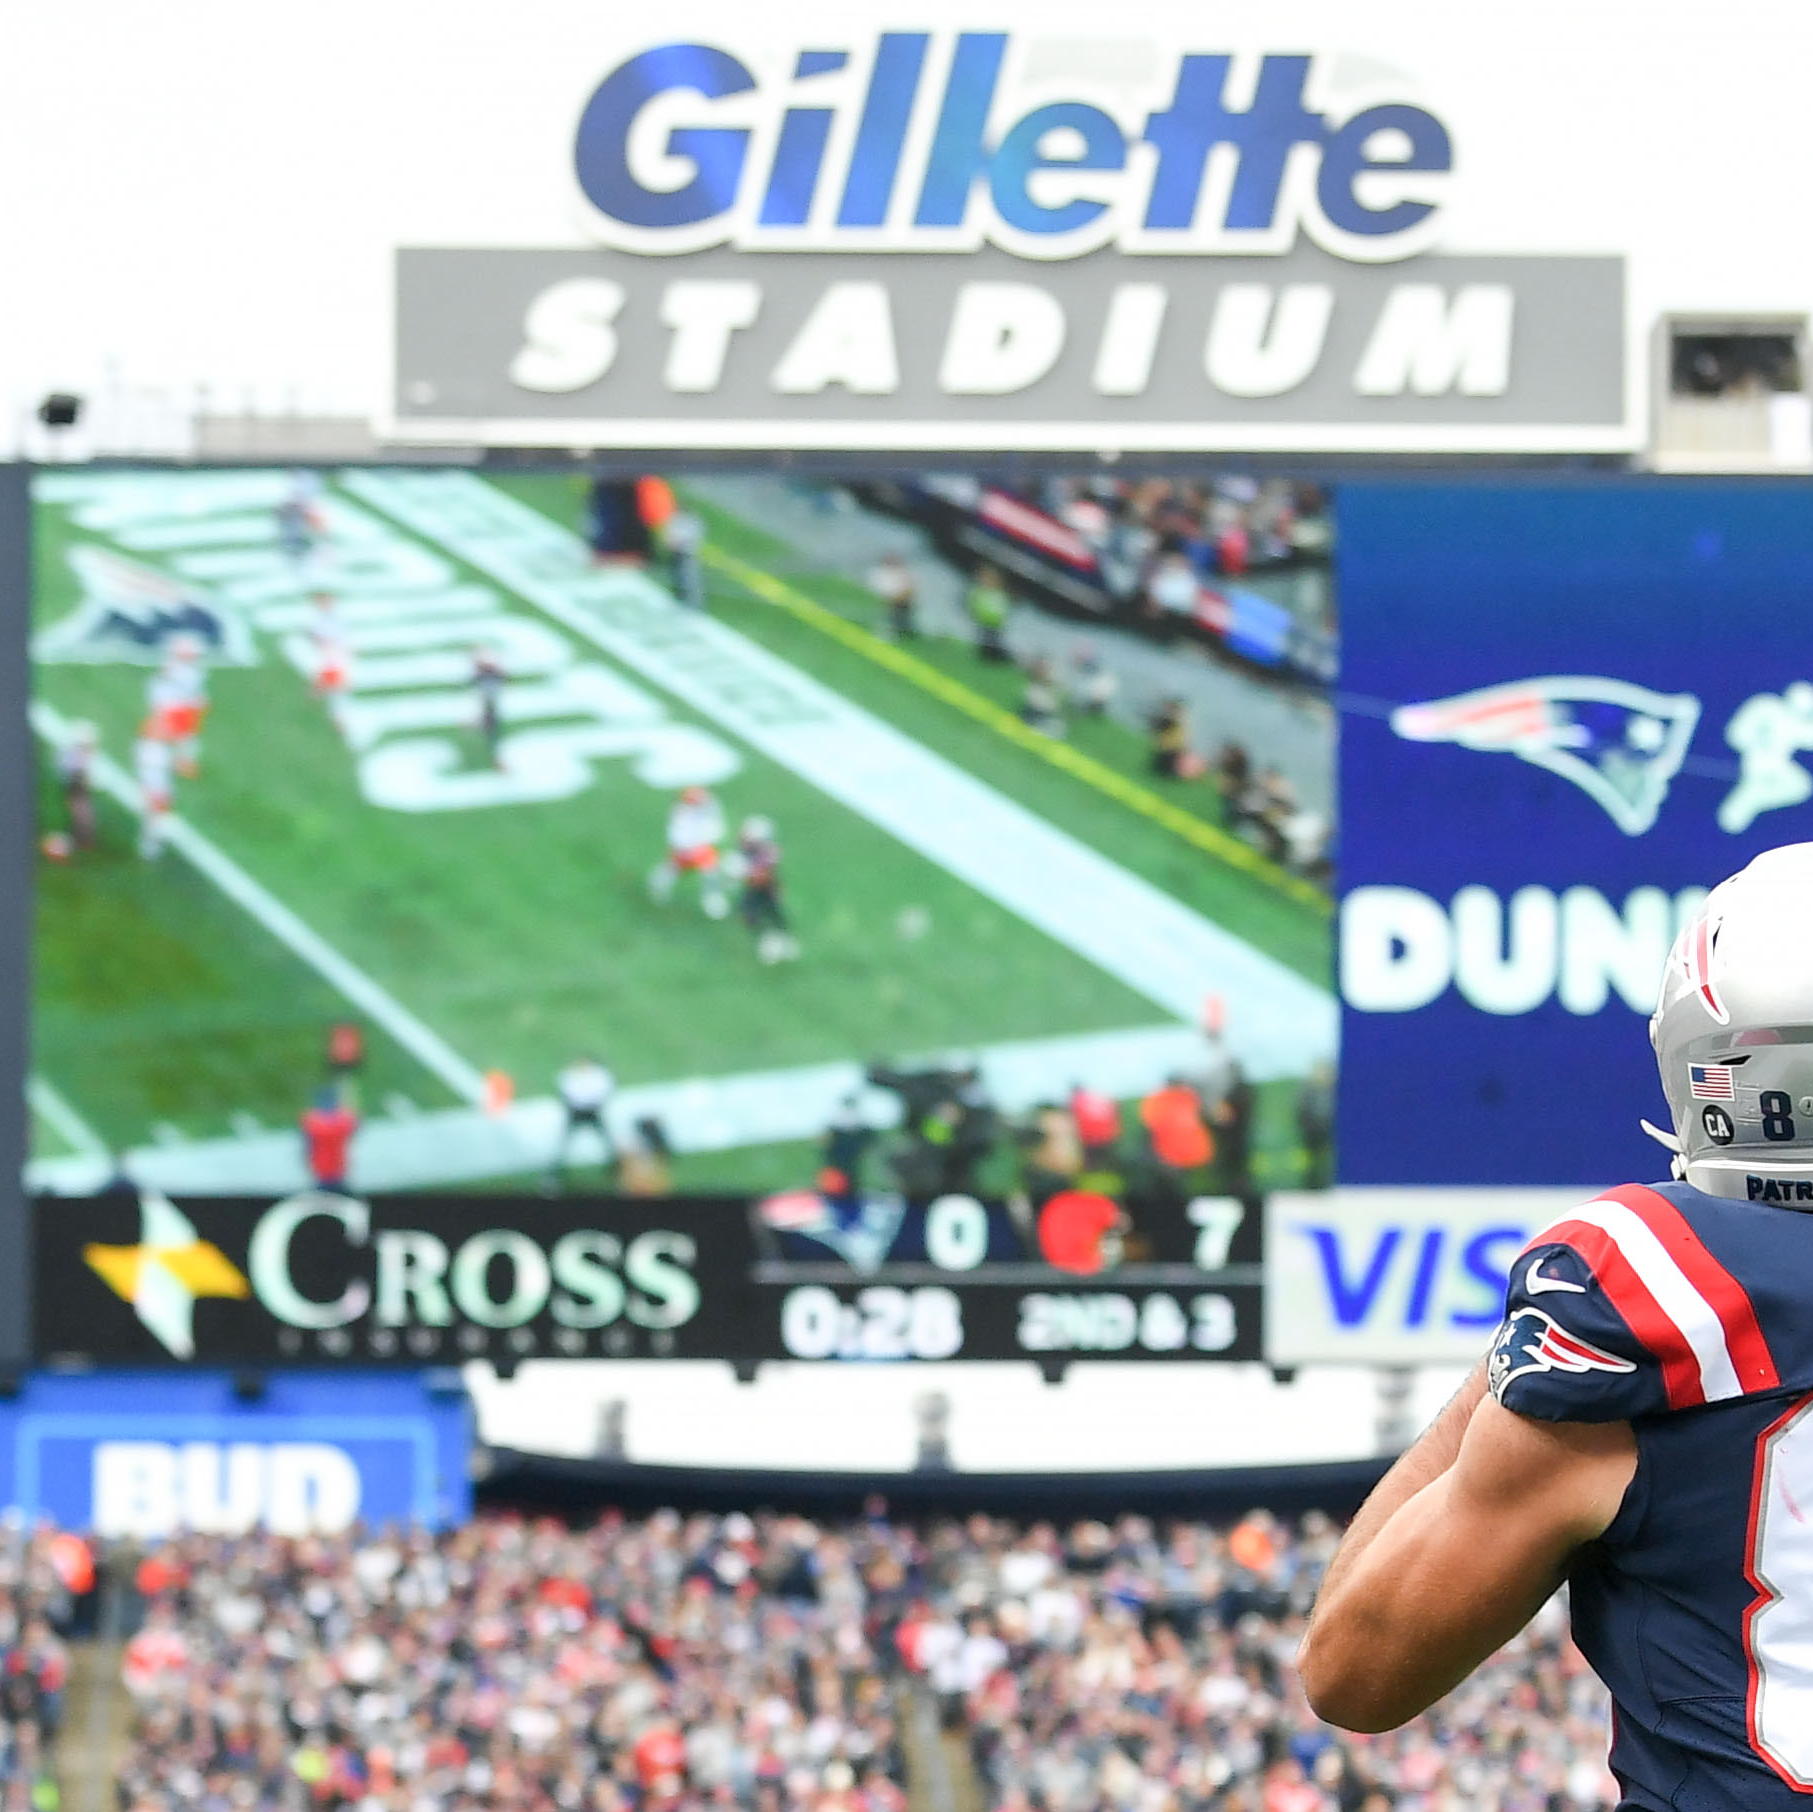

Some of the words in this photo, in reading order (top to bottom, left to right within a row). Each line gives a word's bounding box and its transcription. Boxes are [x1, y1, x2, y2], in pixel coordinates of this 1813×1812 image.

[571, 30, 1453, 236] Gillette
[508, 279, 1514, 398] STADIUM
[1339, 882, 1718, 1015] DUN
[1705, 1113, 1731, 1138] CA
[925, 1193, 988, 1272] 0
[1187, 1195, 1245, 1272] 7
[1304, 1224, 1526, 1330] VIS
[780, 1284, 964, 1360] 0:28
[92, 1439, 363, 1538] BUD
